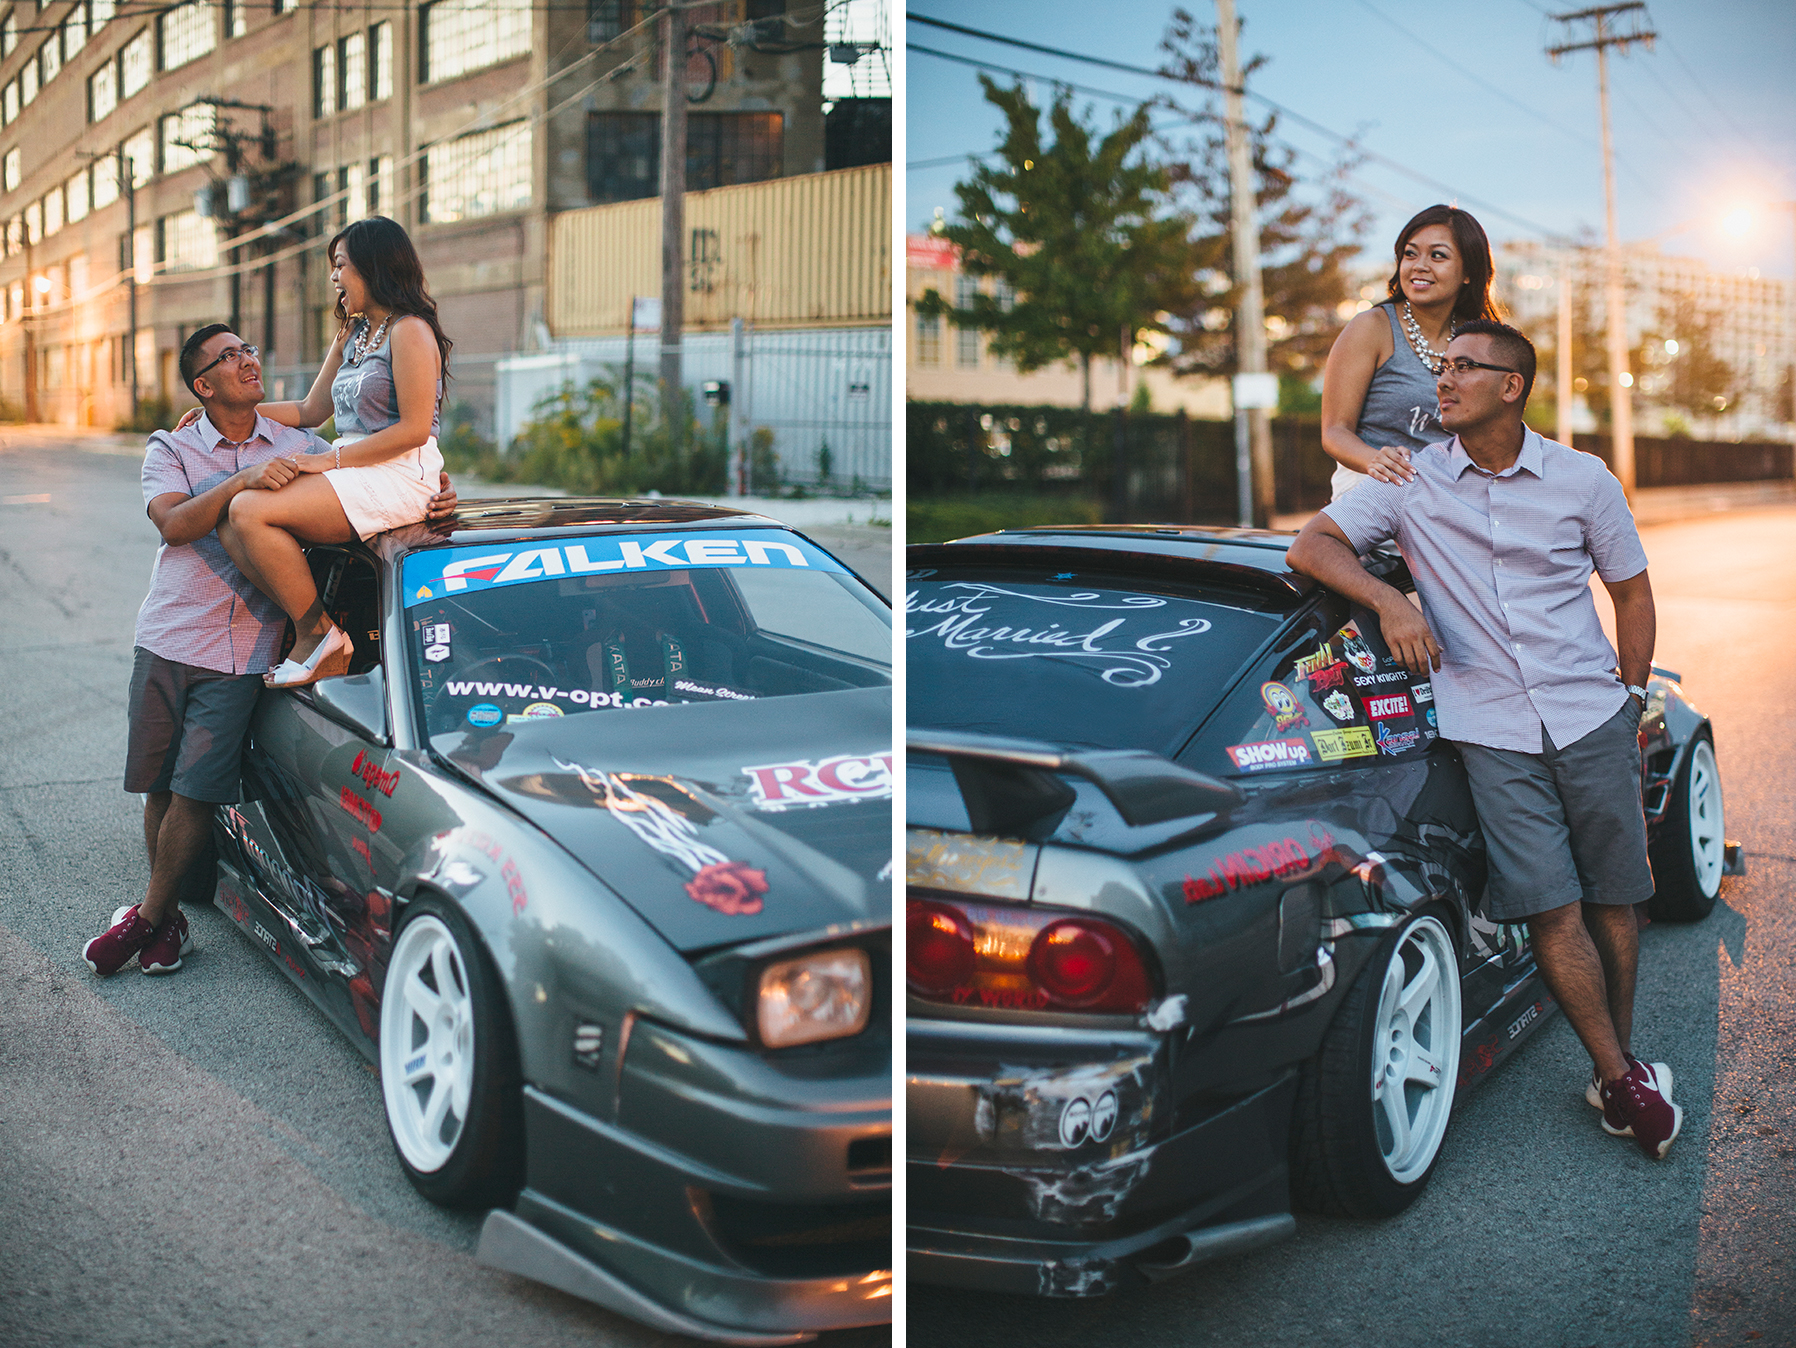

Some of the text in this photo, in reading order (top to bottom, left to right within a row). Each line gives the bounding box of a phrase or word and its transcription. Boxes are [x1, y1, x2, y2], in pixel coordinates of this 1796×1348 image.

[443, 539, 809, 592] FALKEN
[937, 613, 1126, 652] Married
[674, 680, 715, 695] Mean
[1369, 696, 1409, 718] EXCITE!
[746, 753, 892, 804] RC
